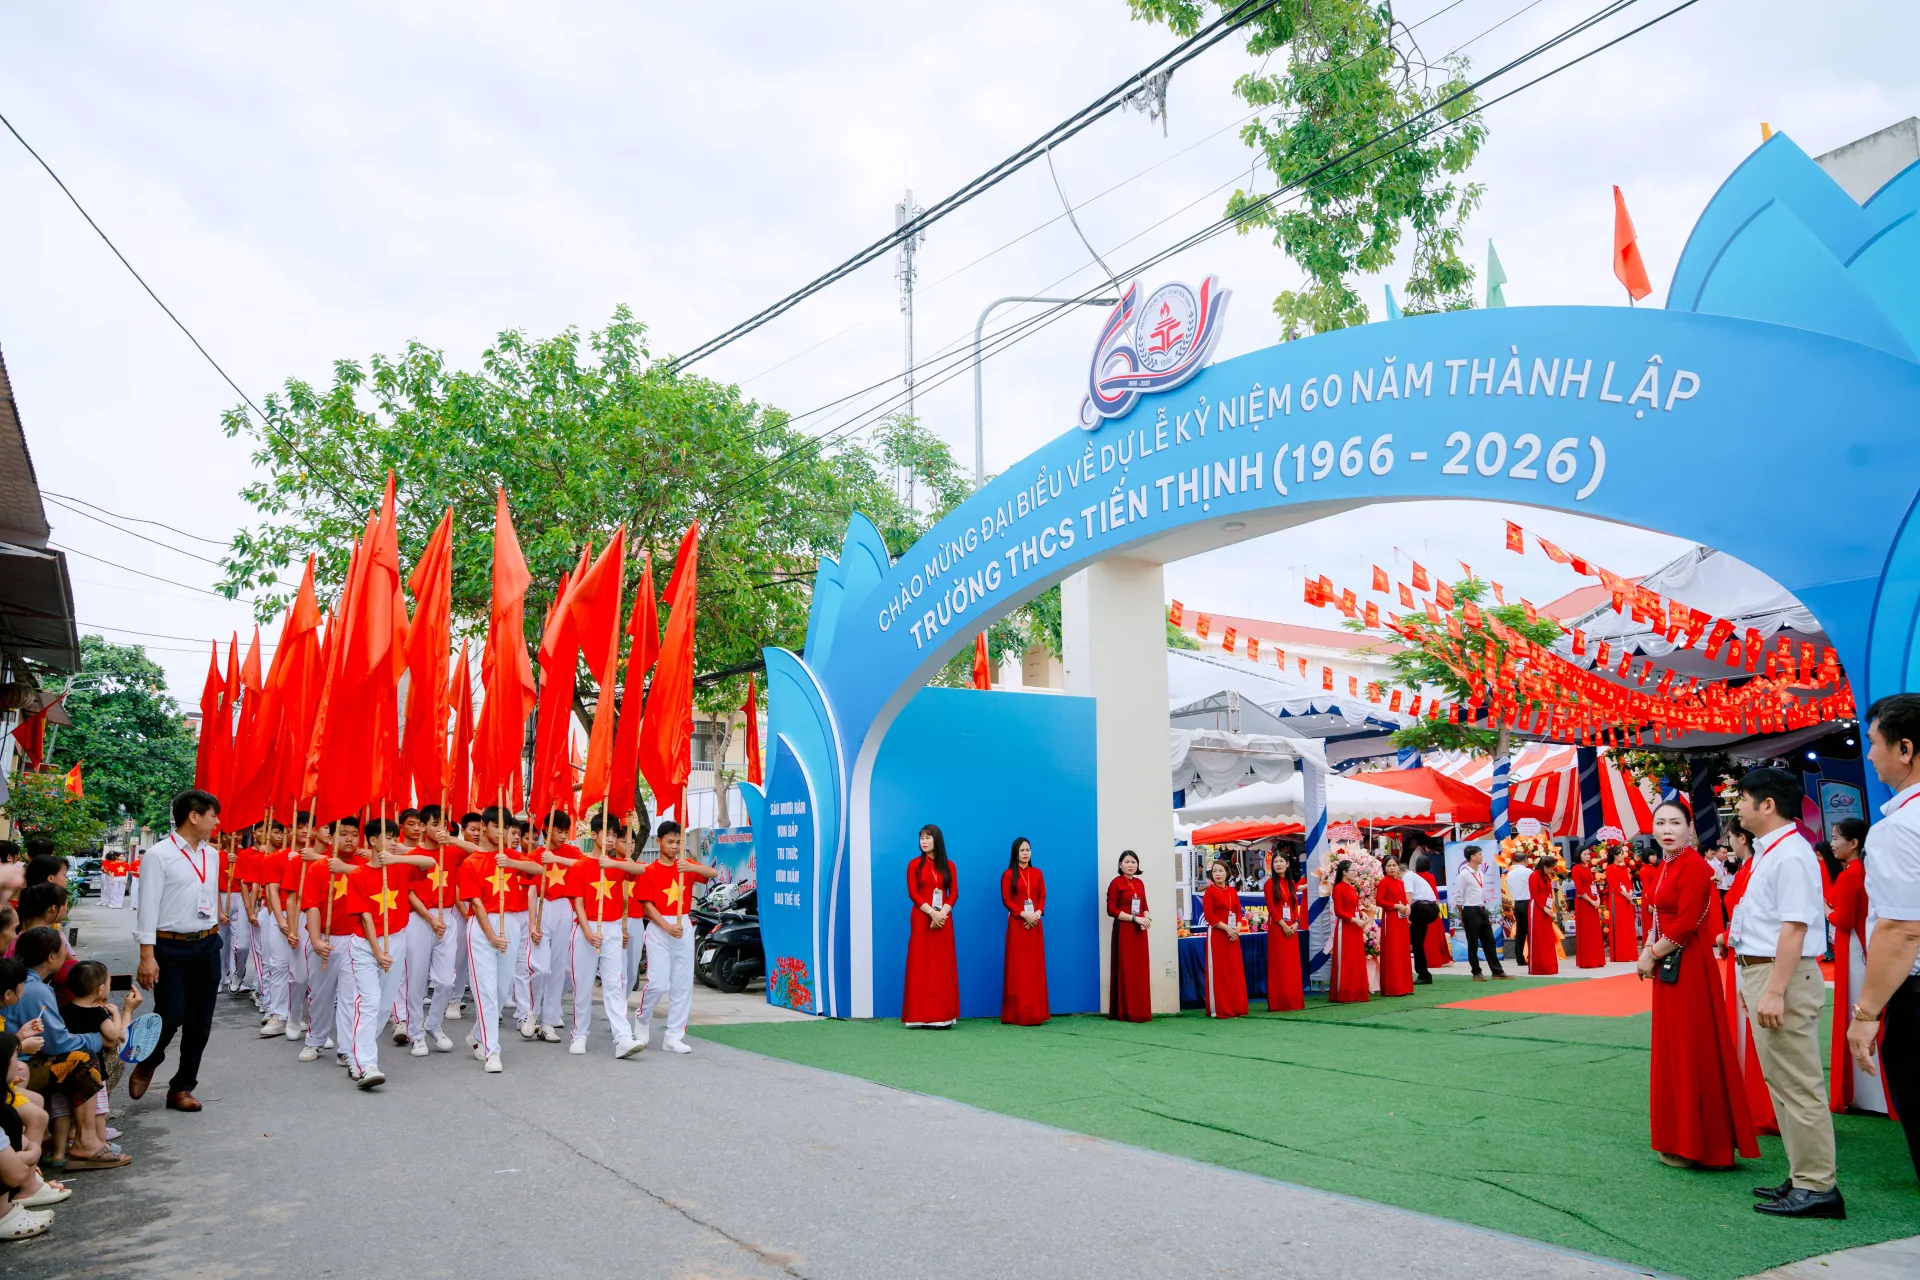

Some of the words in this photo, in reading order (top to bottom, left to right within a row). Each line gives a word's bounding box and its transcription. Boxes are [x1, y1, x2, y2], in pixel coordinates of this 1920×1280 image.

[880, 575, 922, 631] CHÀO
[925, 527, 978, 582] MỪNG
[982, 503, 1012, 541] ĐẠI
[1017, 466, 1061, 518] BIỂU
[1067, 441, 1095, 487] VỀ
[1101, 431, 1134, 473] DỰ
[1140, 407, 1168, 457] LỄ
[1177, 396, 1210, 443] KỶ
[1220, 383, 1290, 431] NIỆM
[1301, 374, 1342, 410] 60
[1352, 356, 1432, 403] NĂM
[1445, 346, 1592, 397] THÀNH
[1600, 355, 1700, 418] LẬP
[910, 559, 1000, 648] TRƯỜNG
[1006, 518, 1074, 577] THCS
[1081, 477, 1147, 538] TIẾN
[1156, 452, 1262, 511] THỊNH
[1274, 434, 1393, 495] (1966
[1411, 452, 1427, 460] -
[1443, 432, 1605, 499] 2026)
[777, 825, 788, 837] VUN
[777, 847, 785, 860] TRI
[784, 889, 793, 905] THẾ
[793, 891, 800, 909] HỆ
